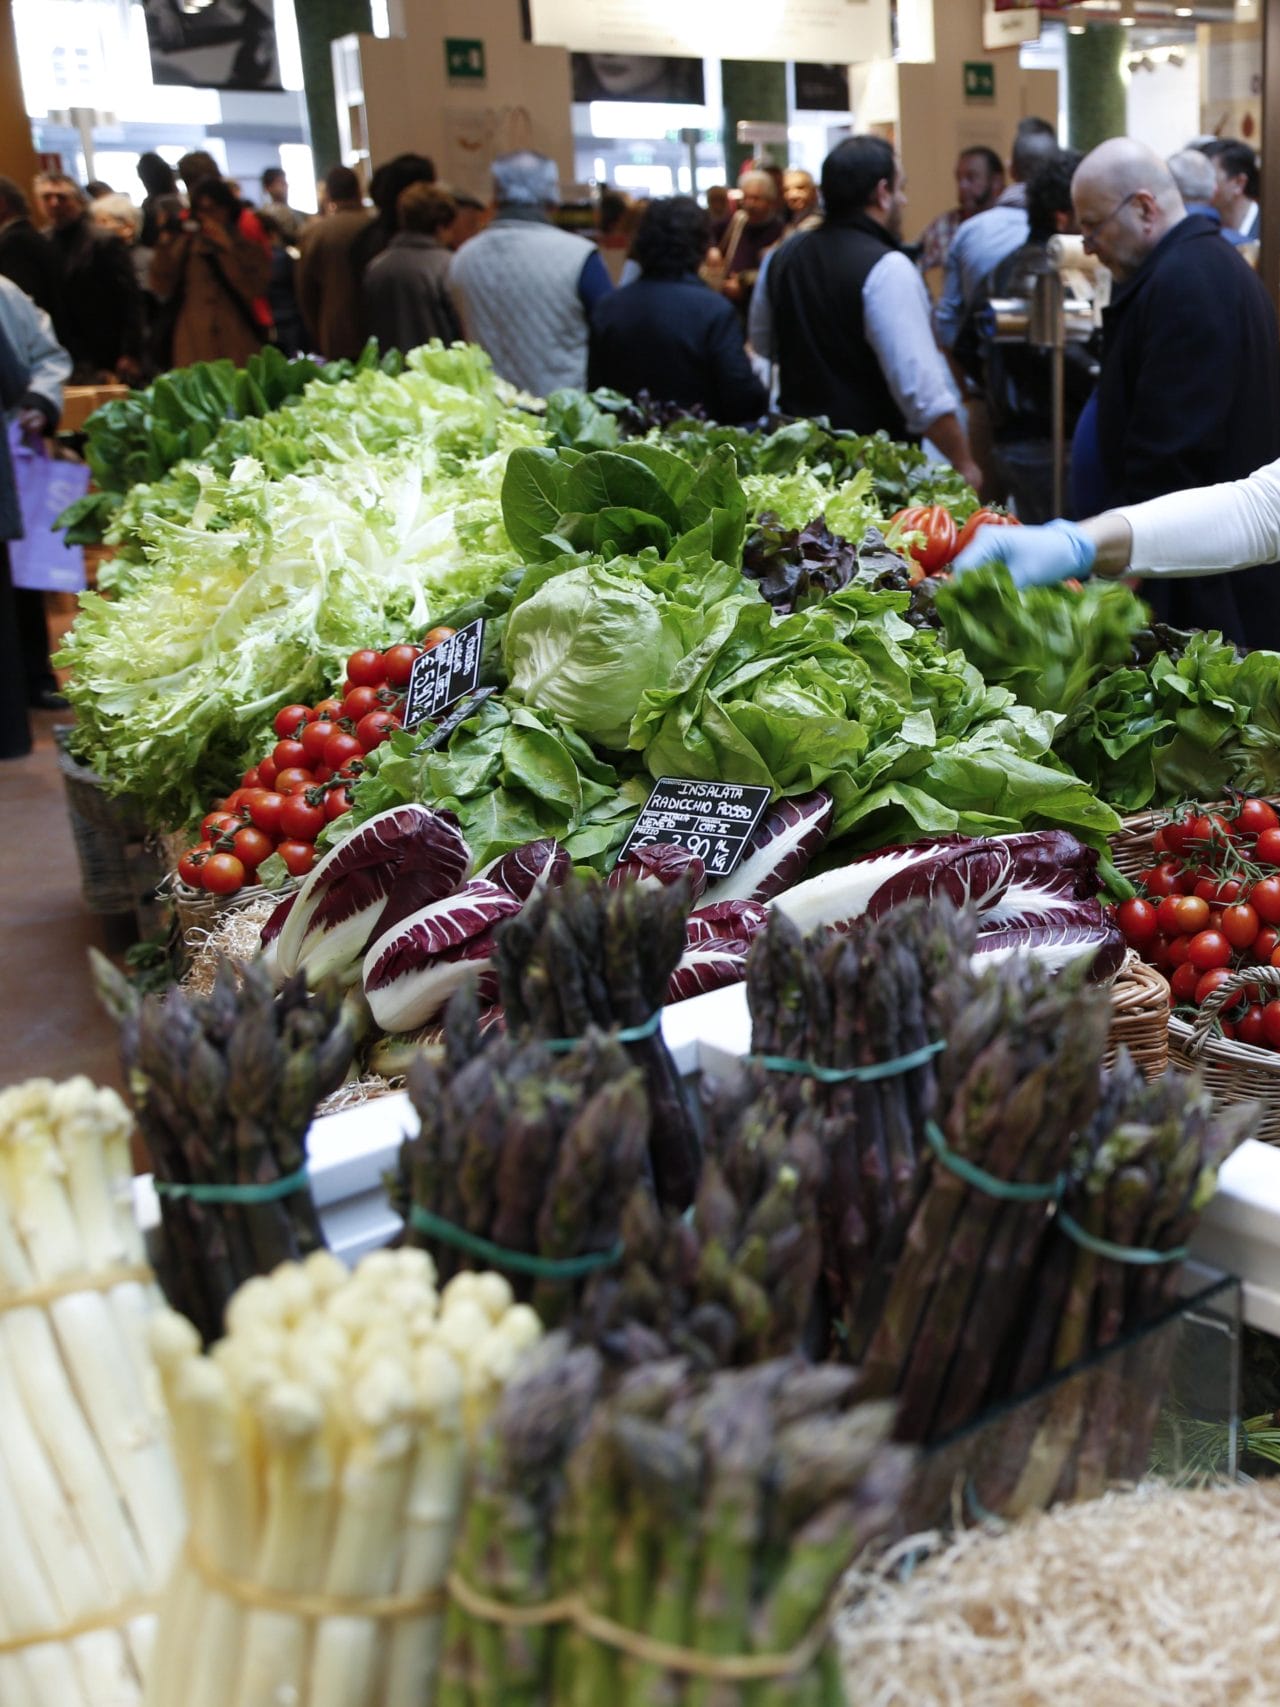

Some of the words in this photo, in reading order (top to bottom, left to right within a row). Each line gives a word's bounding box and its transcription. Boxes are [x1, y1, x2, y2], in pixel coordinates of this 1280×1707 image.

[678, 783, 744, 800] INSALATA
[650, 795, 713, 813] RADICCHIO
[716, 801, 752, 819] ROSSO
[641, 816, 676, 828] VENETO
